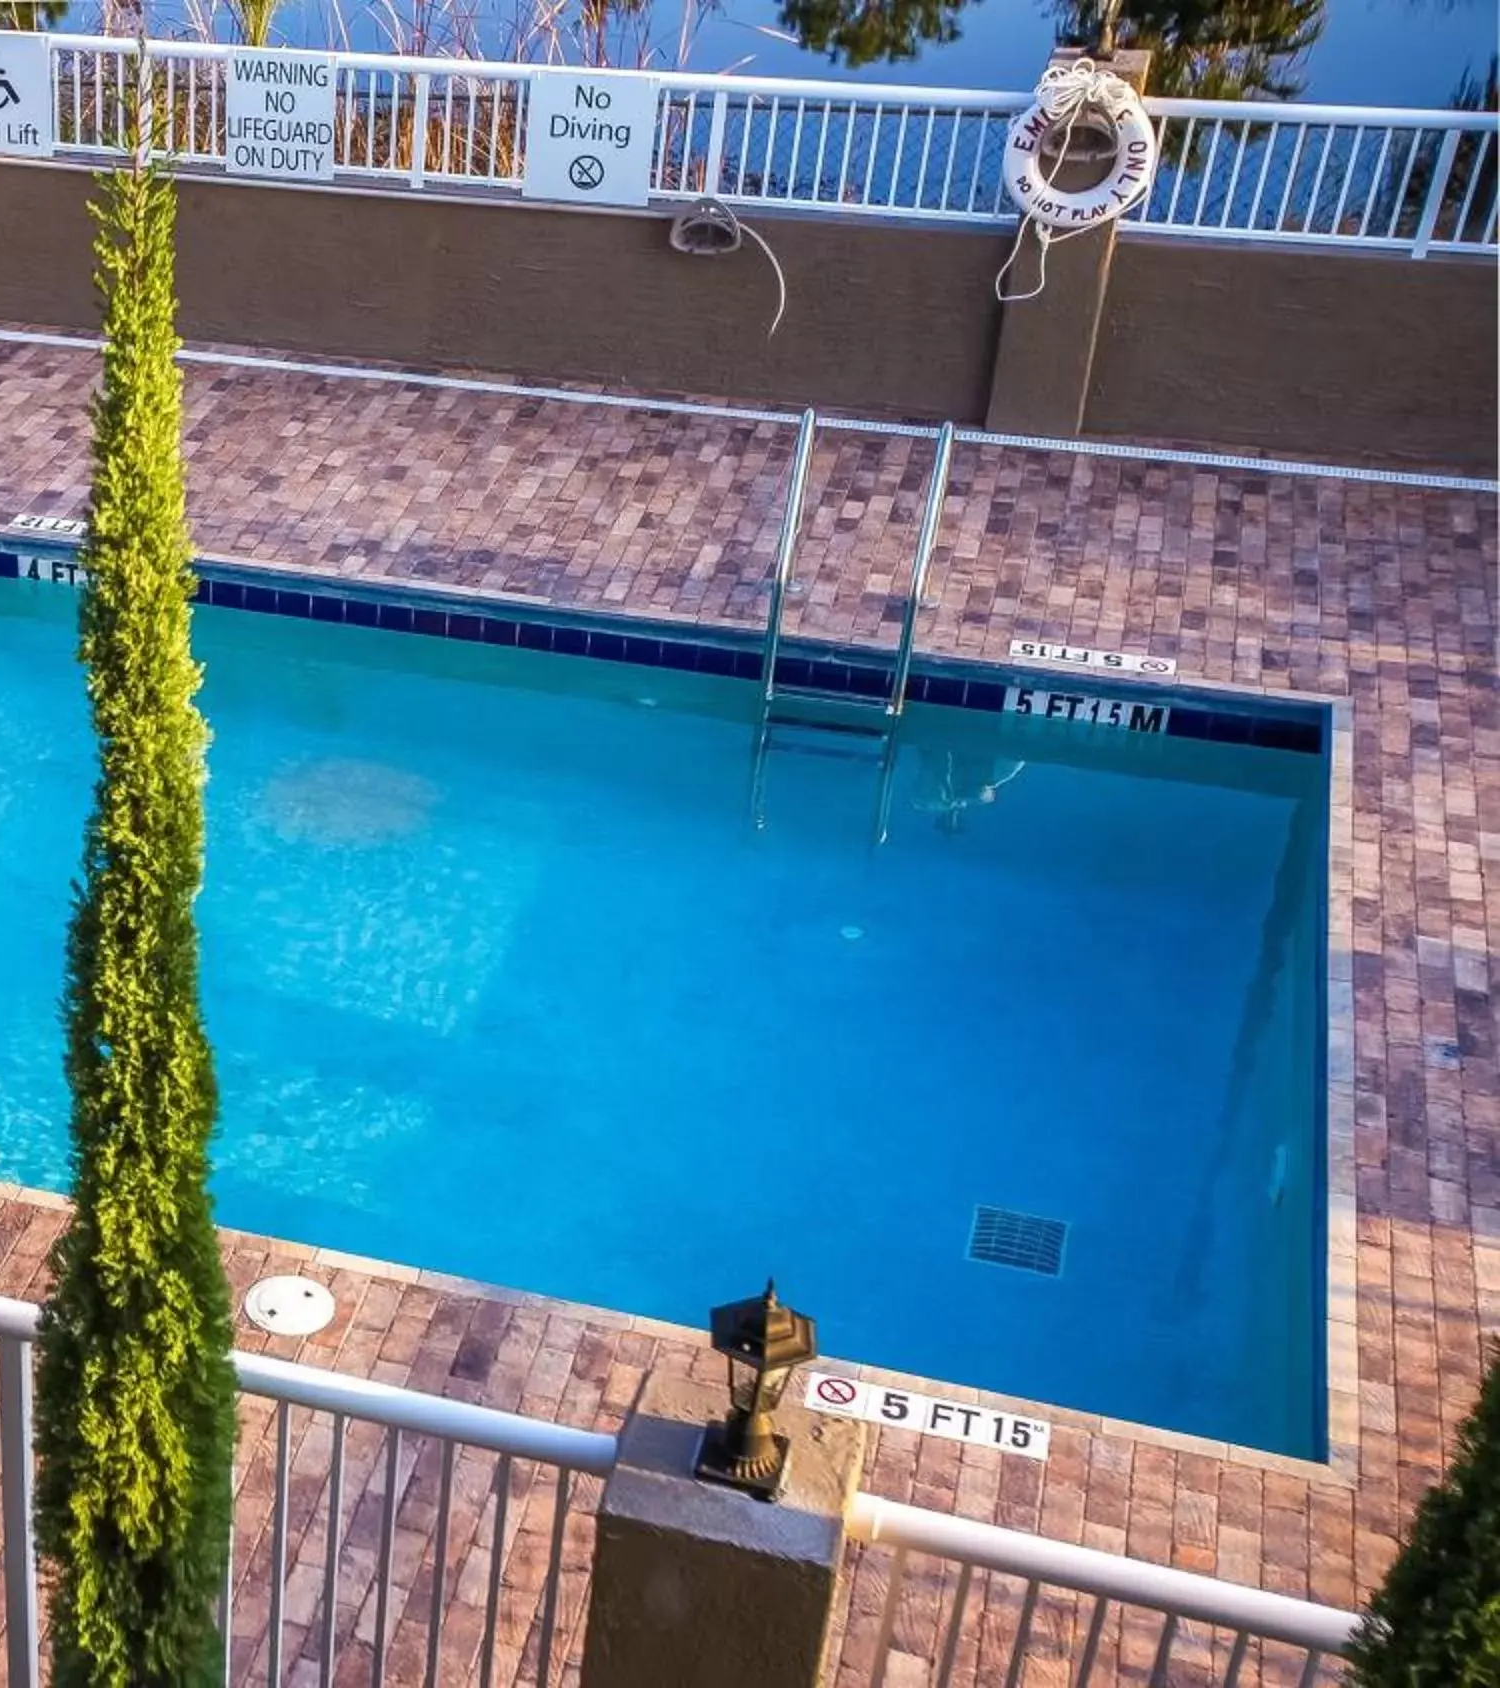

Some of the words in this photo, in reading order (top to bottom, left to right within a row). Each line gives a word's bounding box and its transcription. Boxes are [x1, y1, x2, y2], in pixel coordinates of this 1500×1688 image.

[234, 59, 328, 87] WARNING
[265, 91, 296, 115] NO
[575, 84, 612, 110] No
[7, 123, 39, 146] Lift
[227, 116, 334, 145] LIFEGUARD
[550, 114, 631, 149] Diving
[235, 145, 265, 167] ON
[271, 147, 325, 172] DUTY
[1110, 140, 1149, 204] ONLY
[1071, 202, 1108, 221] PLAY
[28, 558, 41, 580] 4
[52, 561, 78, 587] FT
[1015, 690, 1035, 715] 5
[880, 1392, 909, 1421] 5
[929, 1402, 980, 1437] FT
